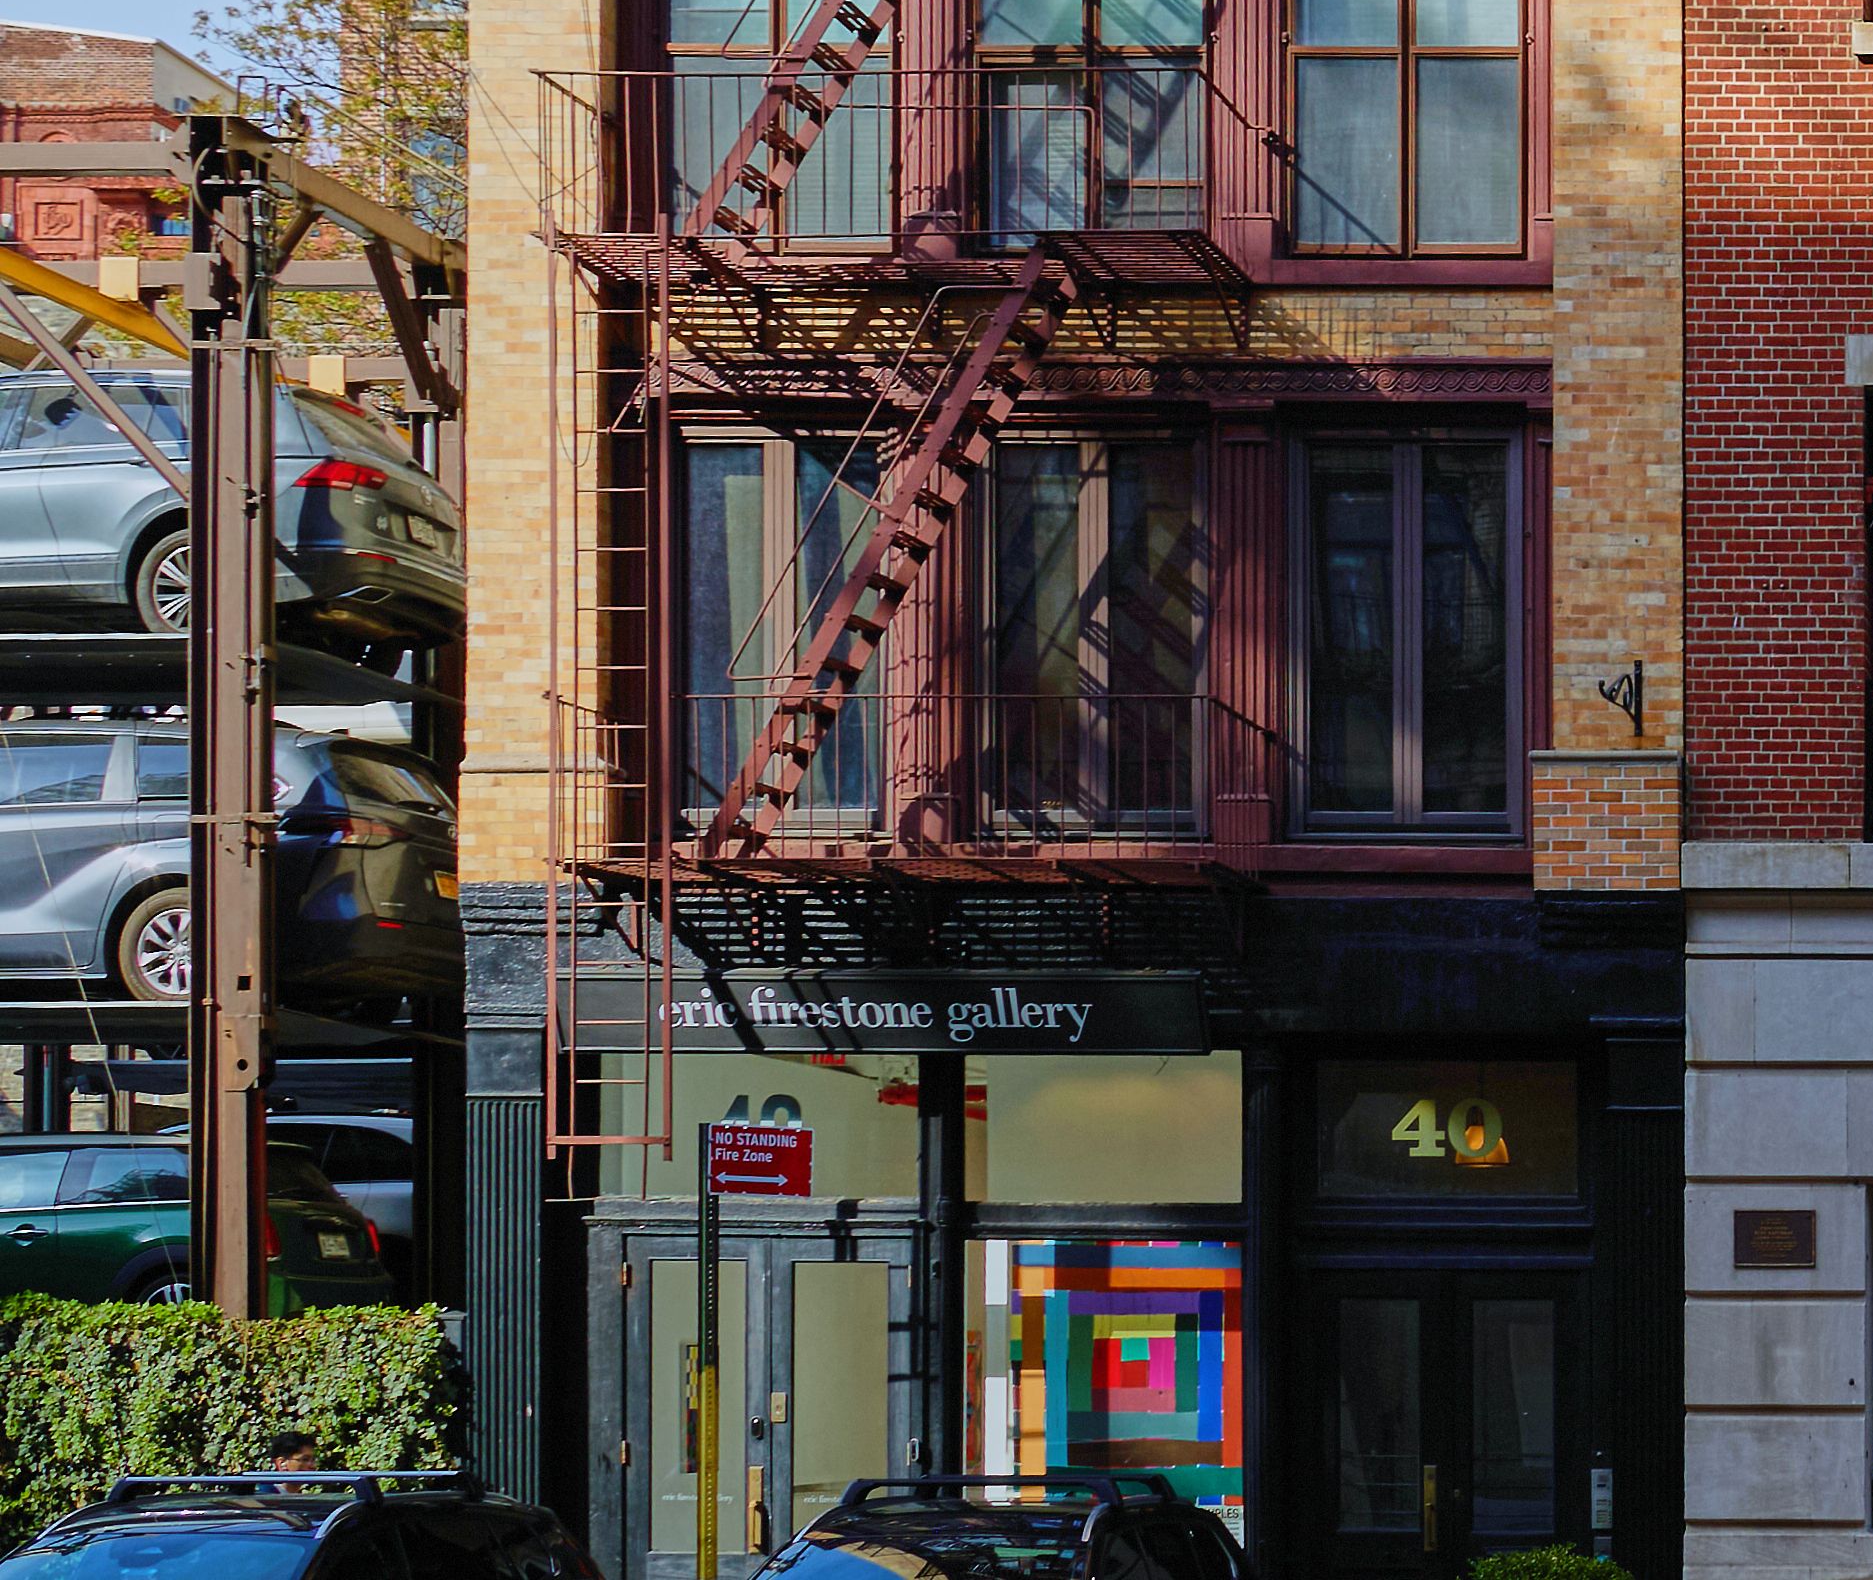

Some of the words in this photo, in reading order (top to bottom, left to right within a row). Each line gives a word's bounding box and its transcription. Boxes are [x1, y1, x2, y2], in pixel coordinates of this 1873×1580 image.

[658, 987, 737, 1028] eric
[748, 986, 933, 1028] firestone
[947, 987, 1093, 1043] gallery
[715, 1132, 733, 1145] NO
[736, 1132, 797, 1148] STANDING
[1391, 1097, 1504, 1157] 40
[715, 1148, 739, 1161] Fire
[743, 1149, 773, 1163] Zone
